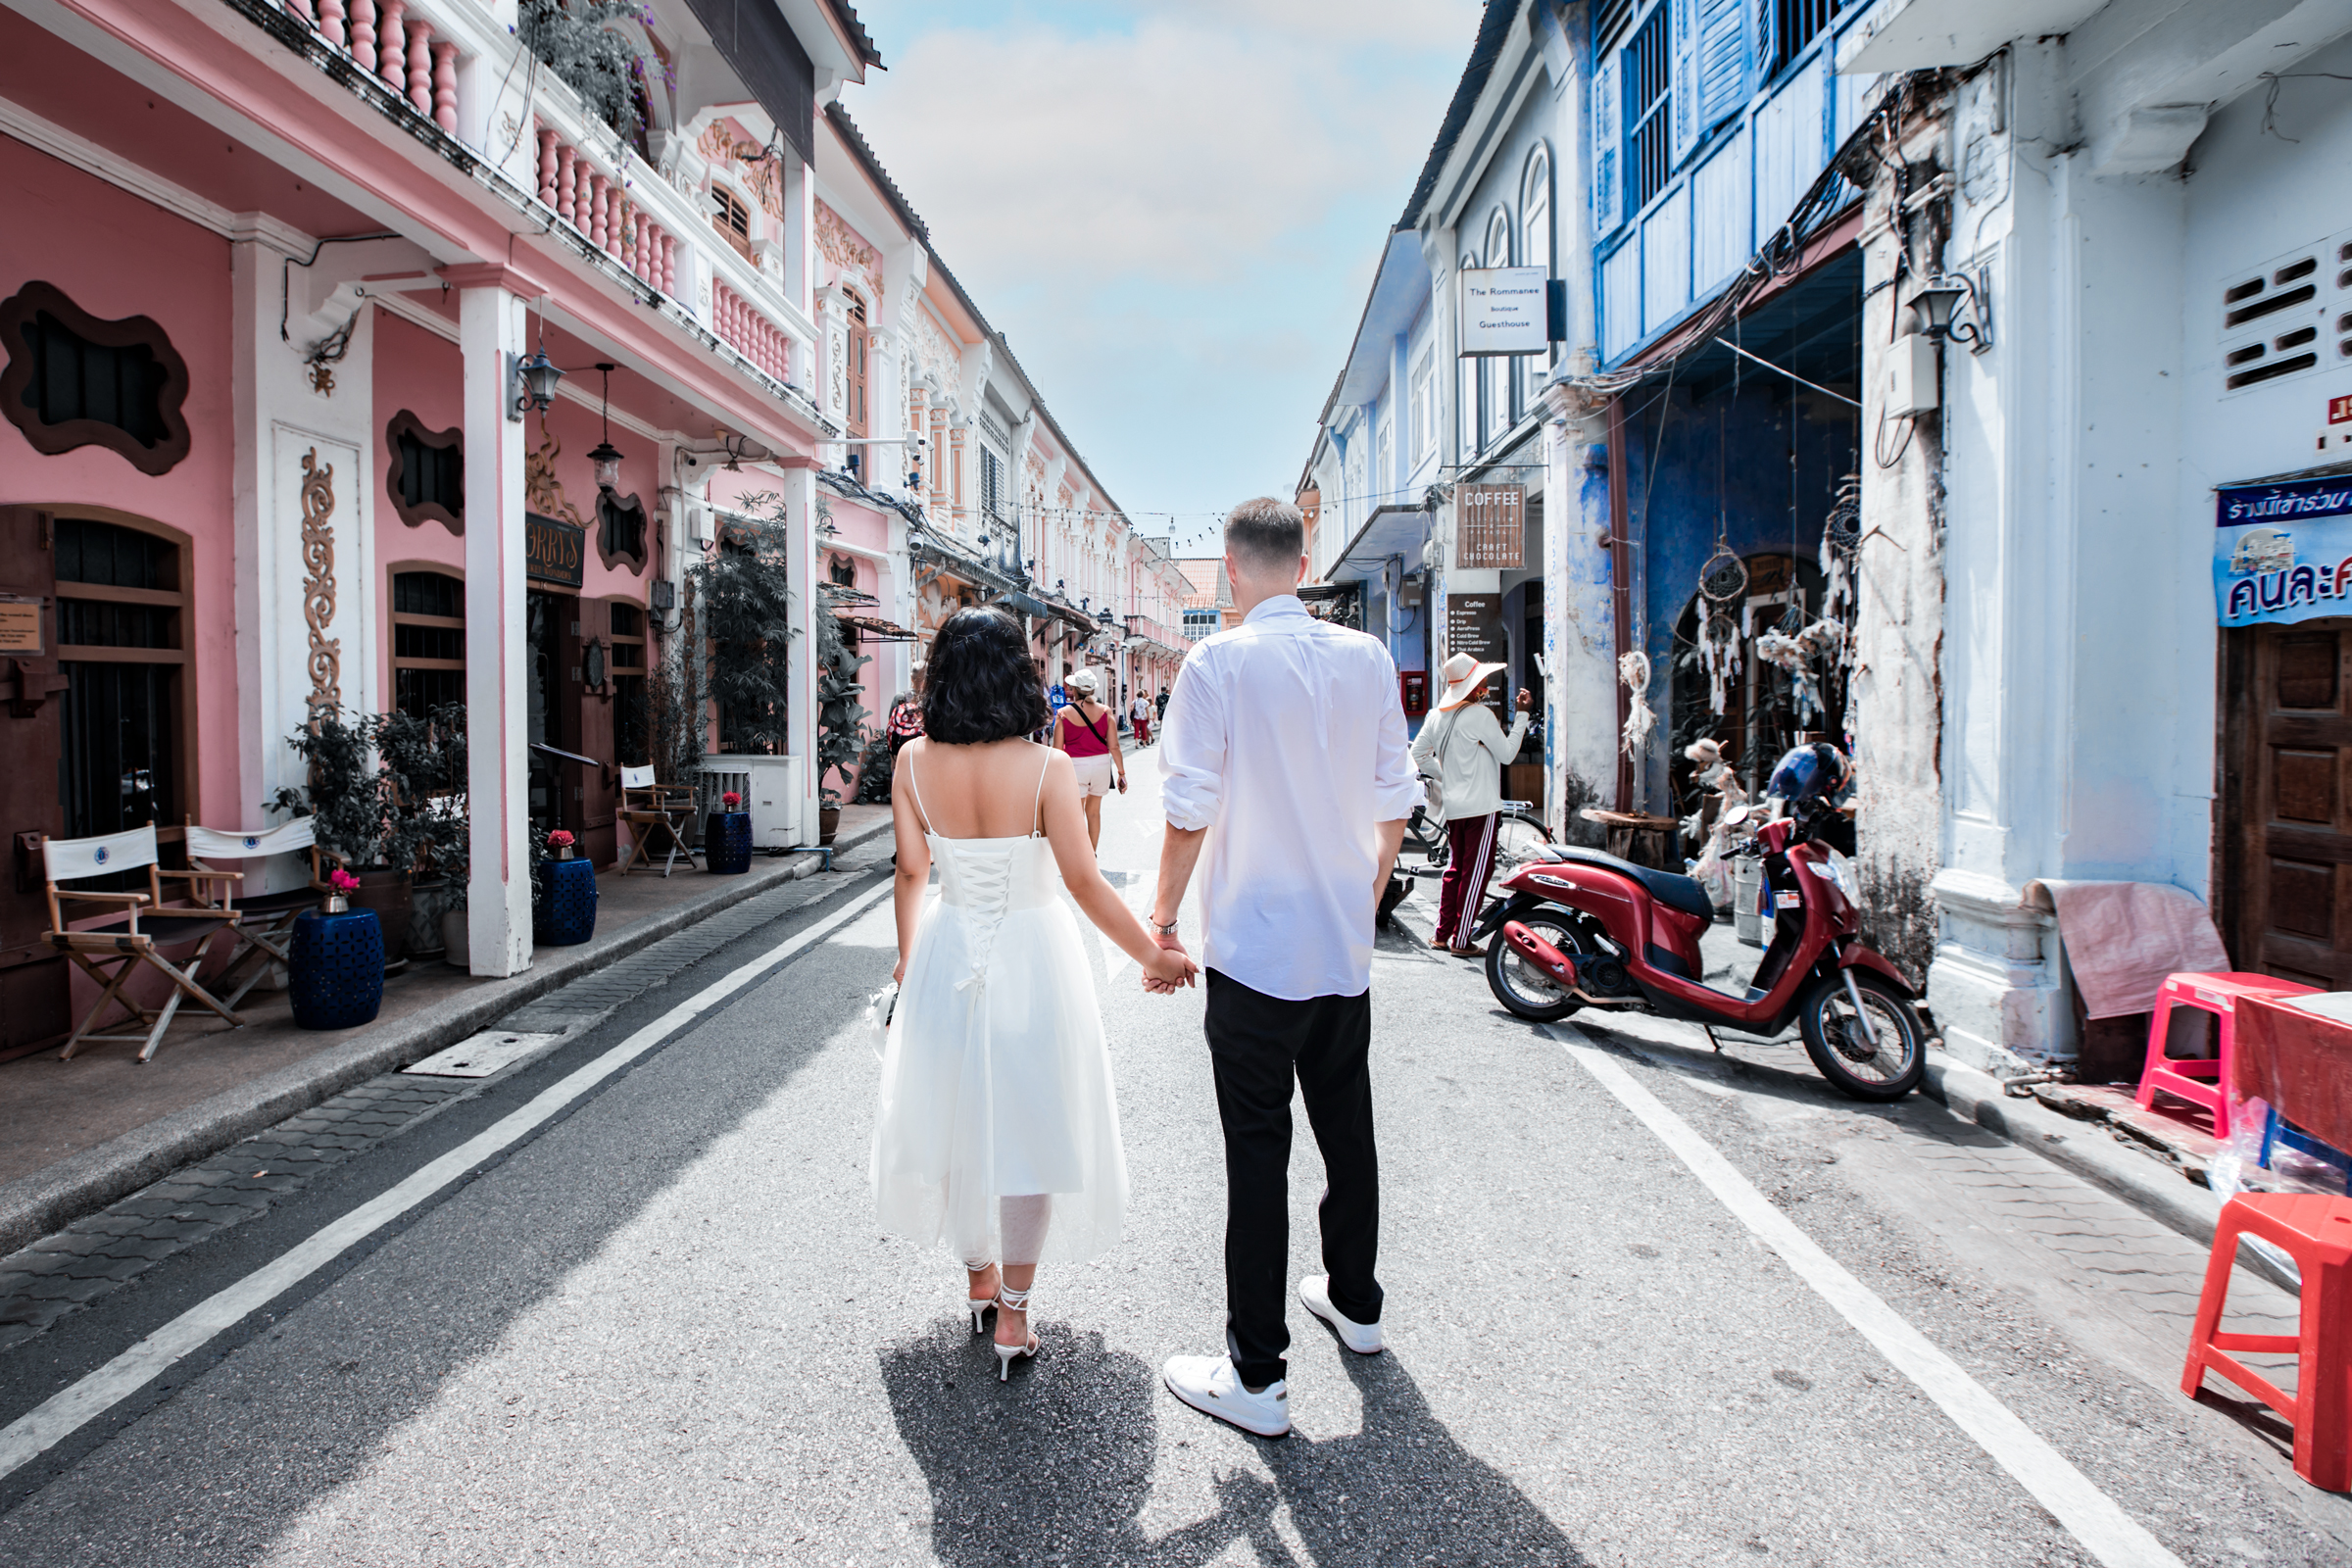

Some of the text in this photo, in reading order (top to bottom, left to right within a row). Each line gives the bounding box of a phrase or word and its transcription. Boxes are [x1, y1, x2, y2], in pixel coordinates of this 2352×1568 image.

[1465, 492, 1519, 505] COFFEE
[526, 522, 578, 568] ORRY'S
[1477, 543, 1507, 552] CRAFT
[1464, 552, 1520, 561] CHOCOLATE
[544, 566, 571, 580] WONDERS
